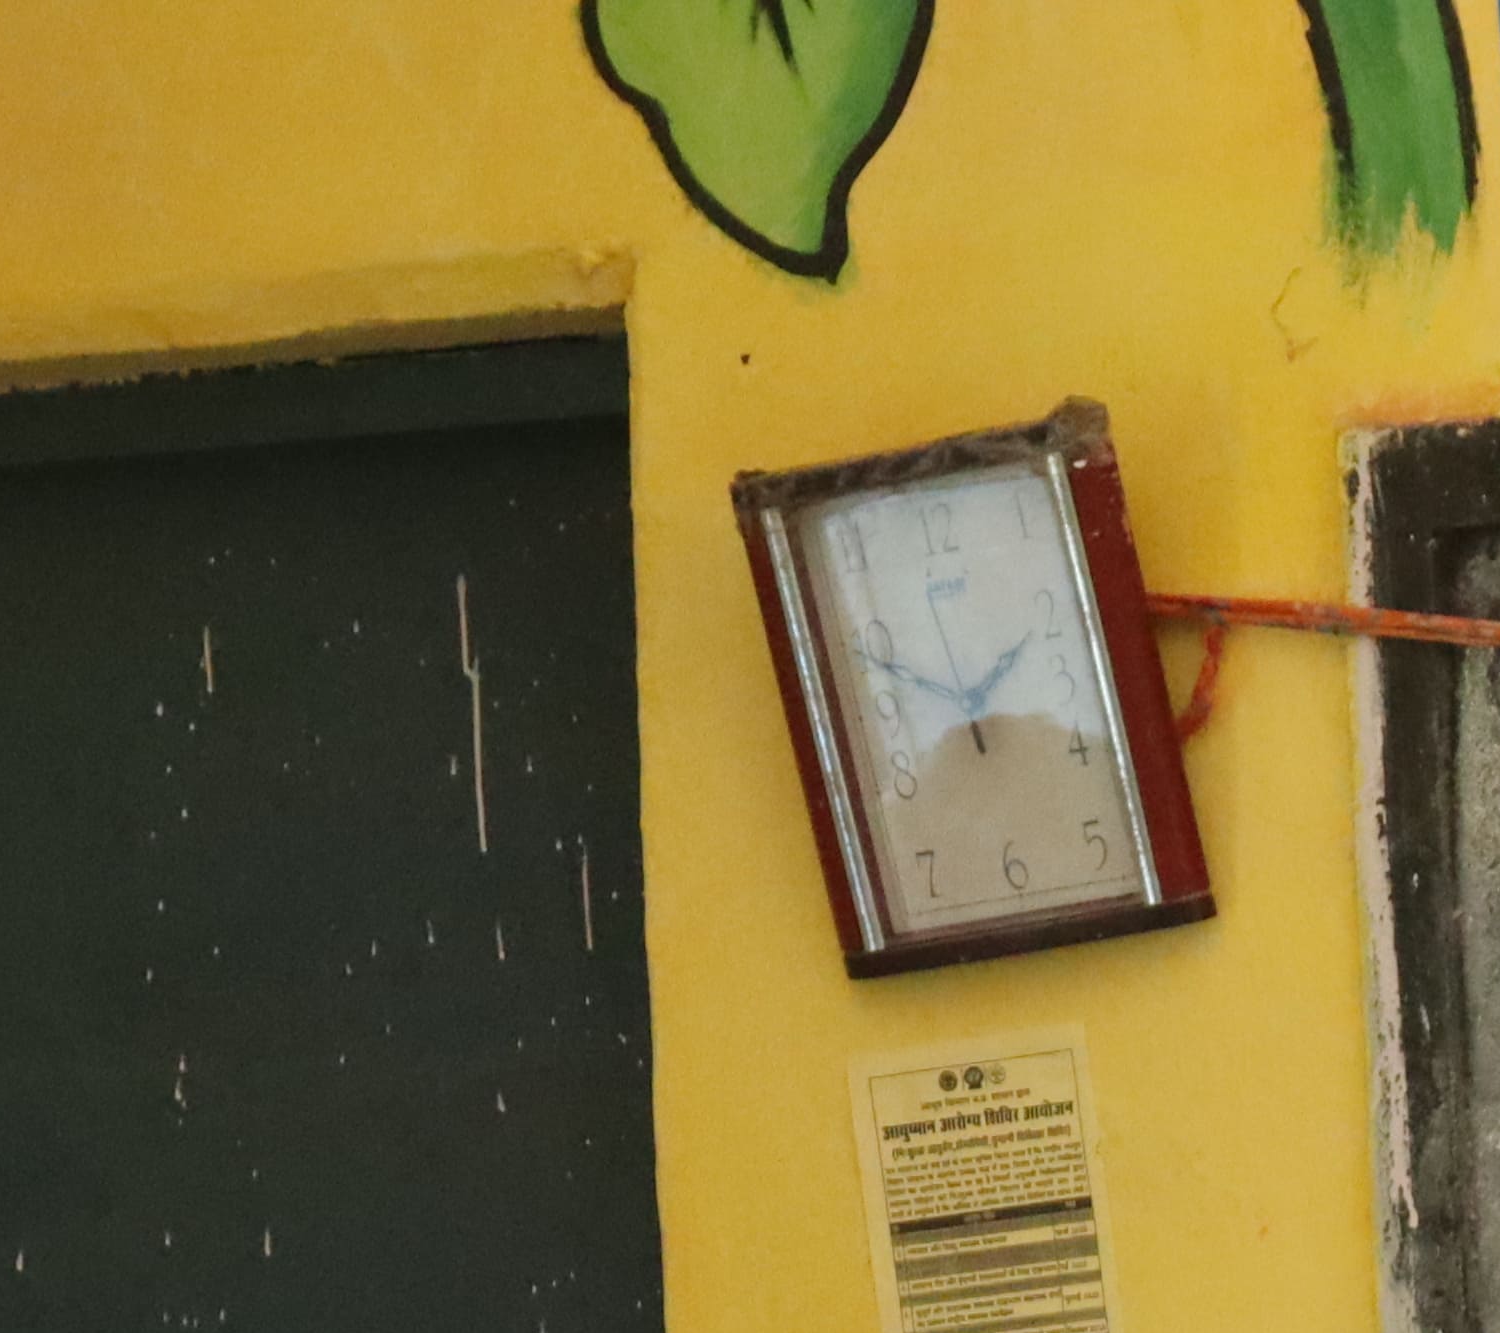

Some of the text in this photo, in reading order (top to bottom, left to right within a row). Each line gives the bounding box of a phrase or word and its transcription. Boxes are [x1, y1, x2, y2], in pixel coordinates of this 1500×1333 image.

[920, 502, 960, 557] 12
[1013, 494, 1034, 541] 1
[1034, 590, 1062, 640] 2
[1052, 654, 1077, 699] 3
[875, 691, 900, 741] 9
[1067, 721, 1091, 767] 4
[893, 751, 919, 800] 8
[1003, 840, 1031, 892] 6
[1082, 819, 1108, 871] 5
[915, 849, 941, 899] 7
